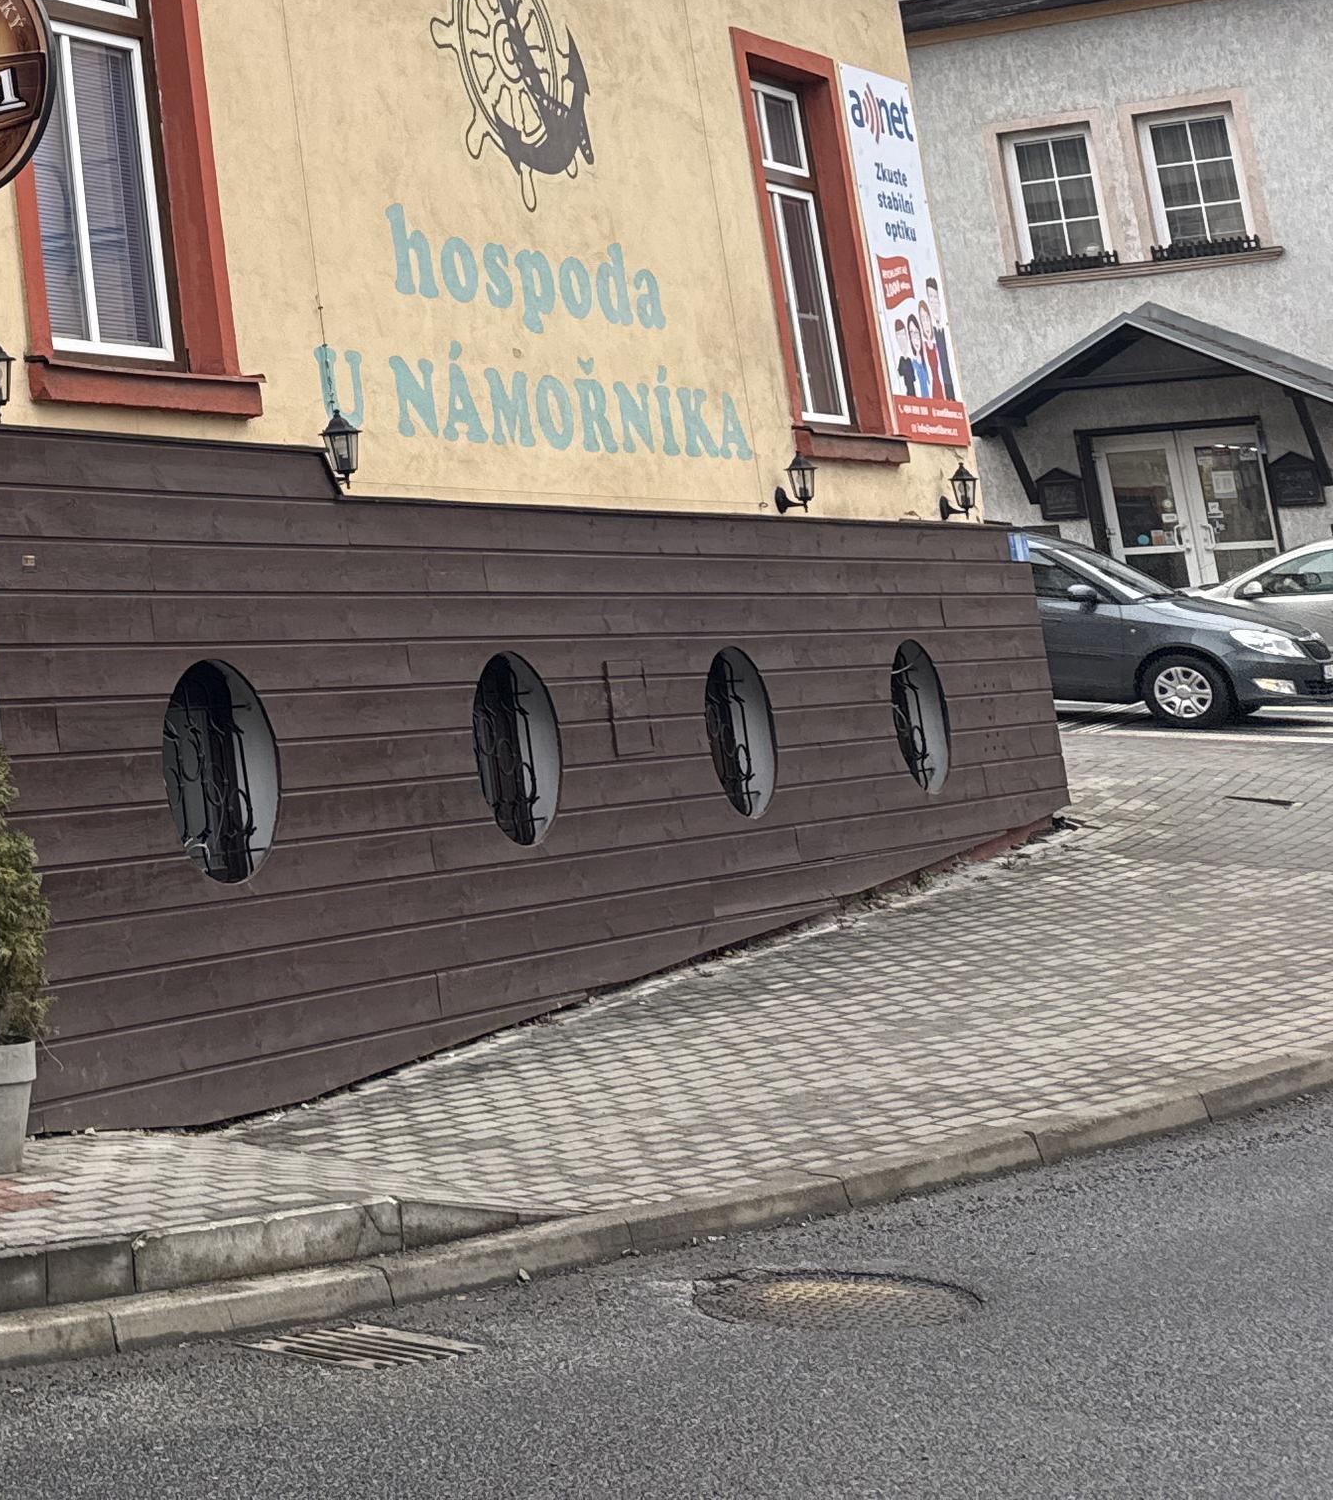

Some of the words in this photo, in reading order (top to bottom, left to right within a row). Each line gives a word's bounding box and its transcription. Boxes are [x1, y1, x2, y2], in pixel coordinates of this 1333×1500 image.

[874, 162, 908, 187] Zkuste
[877, 190, 915, 215] stabilní
[885, 219, 917, 242] optiku
[385, 203, 666, 333] hospoda
[313, 345, 364, 428] U
[389, 340, 753, 460] NÁMOŘNÍKA
